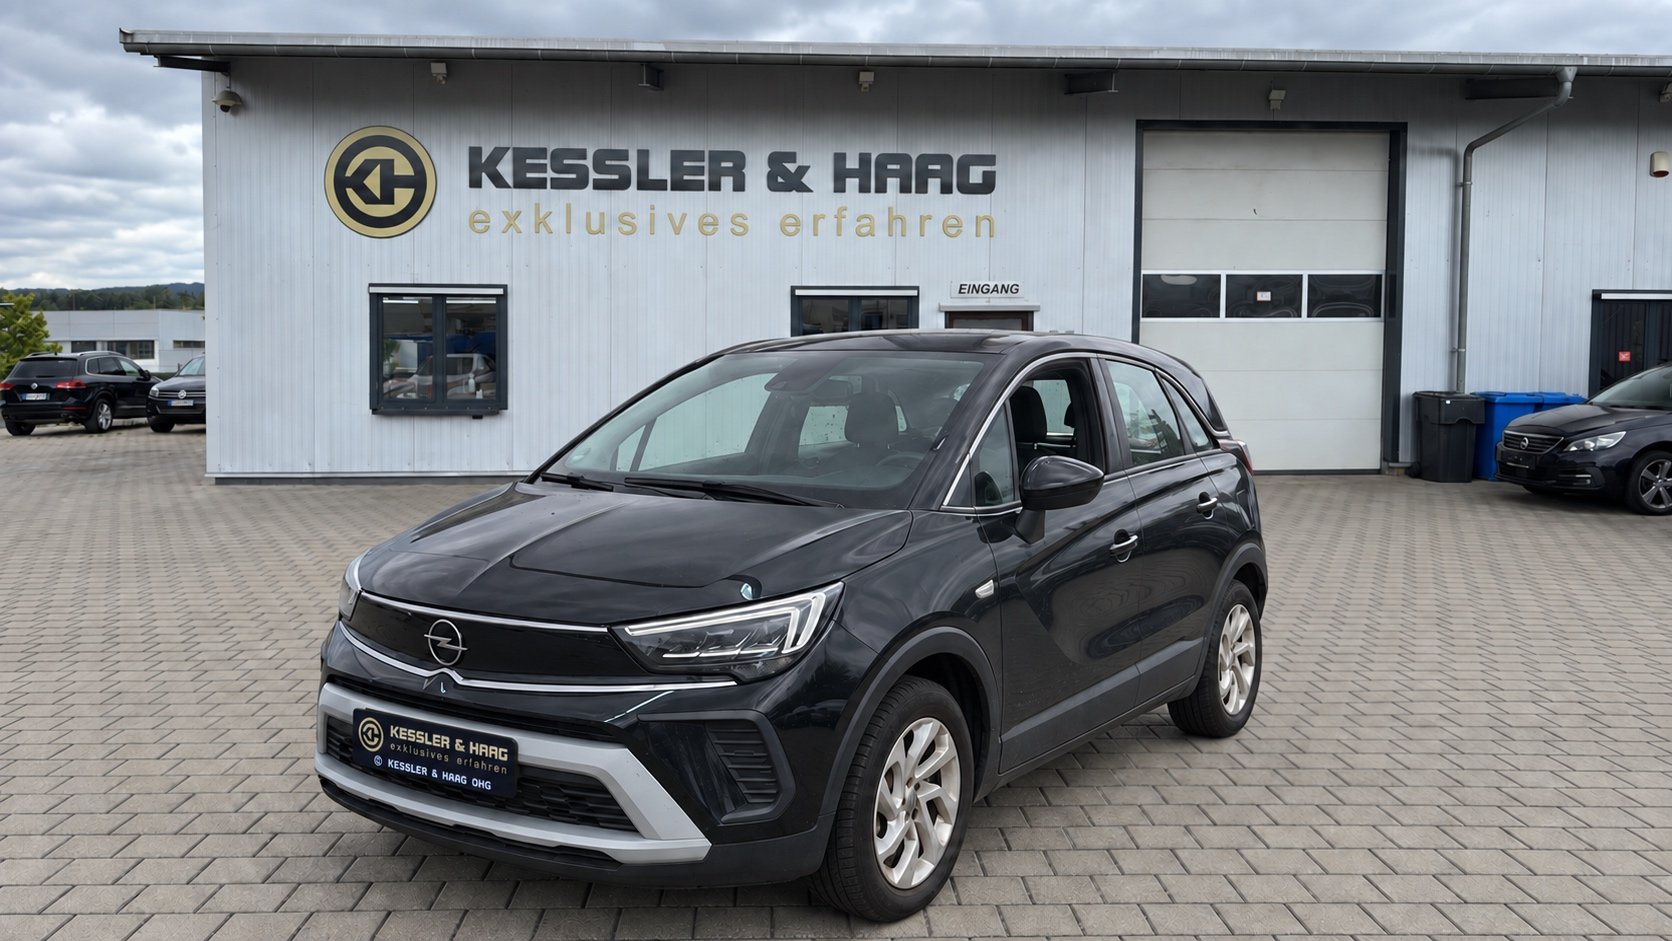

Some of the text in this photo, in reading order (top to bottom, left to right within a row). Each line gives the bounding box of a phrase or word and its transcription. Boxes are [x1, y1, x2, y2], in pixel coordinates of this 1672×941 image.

[468, 146, 997, 195] KESSLER & HAAG
[468, 203, 996, 238] exklusives erfahren
[958, 283, 1020, 295] EINGANG
[390, 725, 450, 749] KESSLER
[455, 738, 465, 752] &
[469, 741, 508, 762] HAAG
[390, 743, 449, 762] exklusives
[456, 757, 508, 775] erfahren
[387, 758, 428, 776] KESSLER
[431, 769, 438, 778] &
[442, 771, 467, 785] HAAG
[471, 778, 492, 790] OHG
